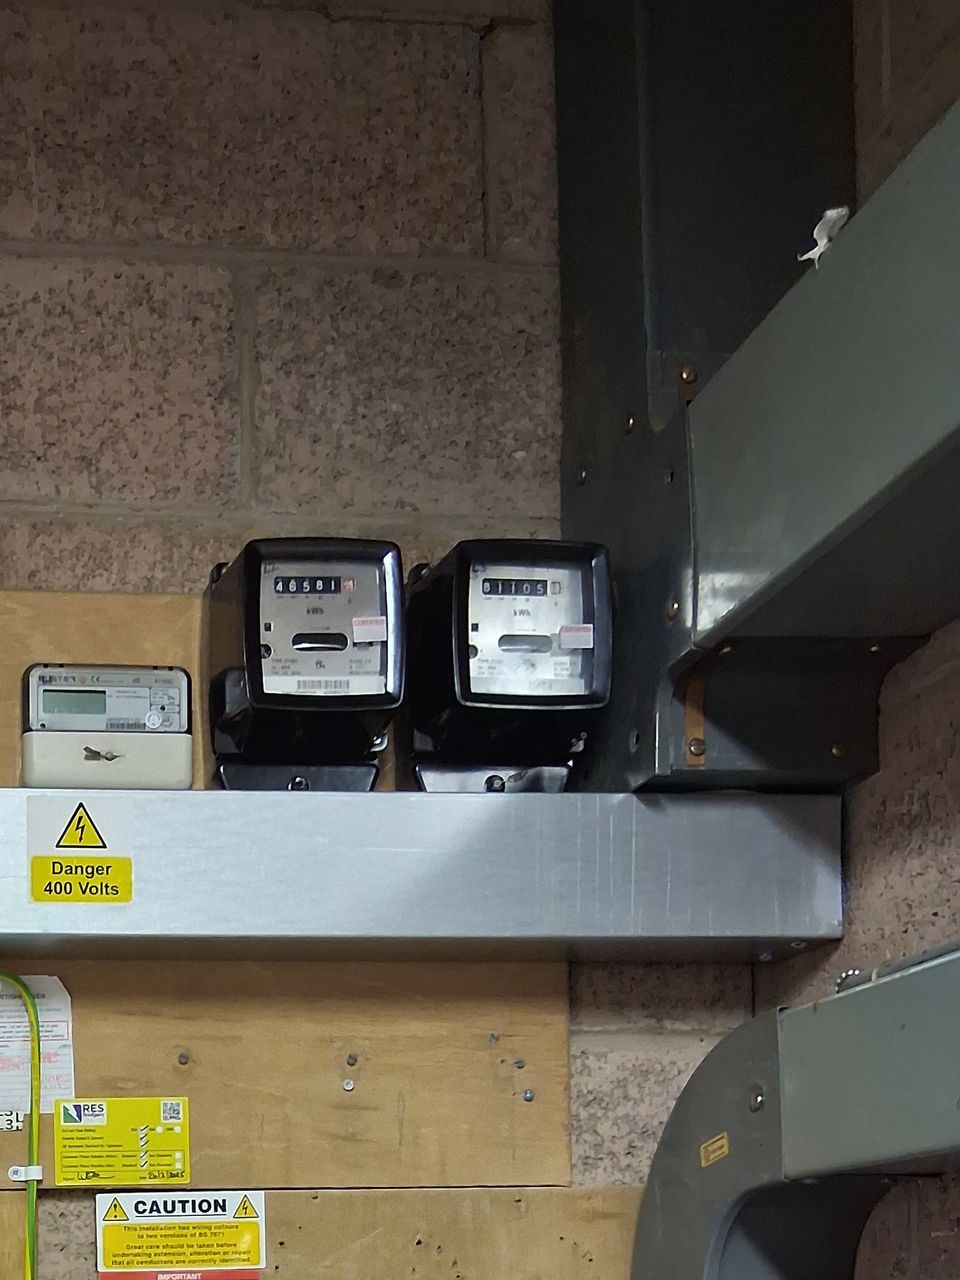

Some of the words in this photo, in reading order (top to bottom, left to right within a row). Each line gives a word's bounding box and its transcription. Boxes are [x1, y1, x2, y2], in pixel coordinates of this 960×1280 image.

[51, 861, 112, 879] Danger
[44, 881, 73, 895] 400
[78, 881, 120, 896] Volts
[83, 1104, 104, 1113] RES
[134, 1199, 227, 1215] CAUTION
[157, 1273, 202, 1280] IMPORTANT
